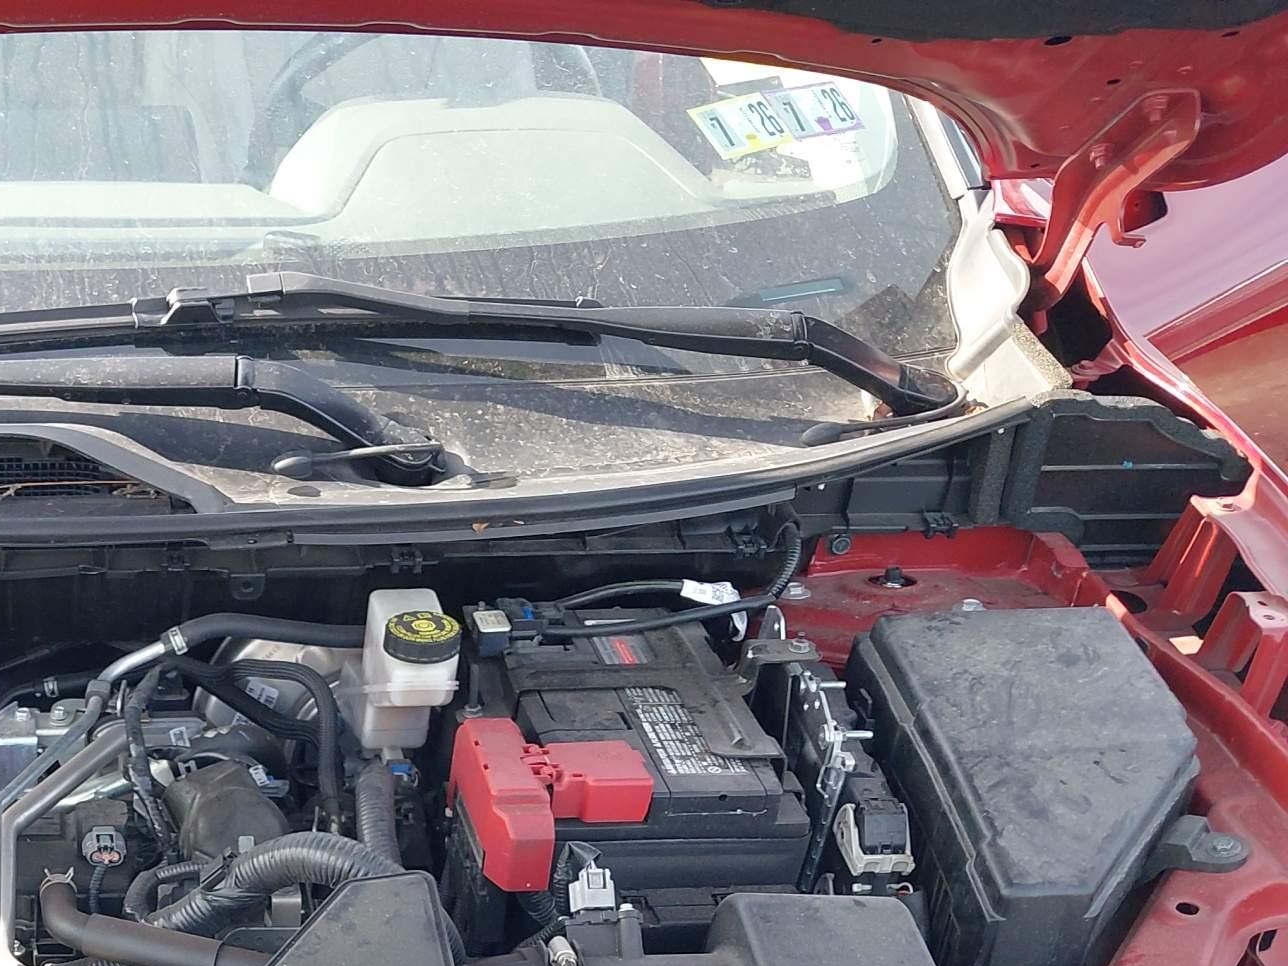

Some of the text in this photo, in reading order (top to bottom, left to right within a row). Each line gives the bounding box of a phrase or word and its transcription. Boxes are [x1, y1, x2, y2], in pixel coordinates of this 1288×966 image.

[709, 101, 785, 147] 7 26
[782, 88, 855, 132] 7 26
